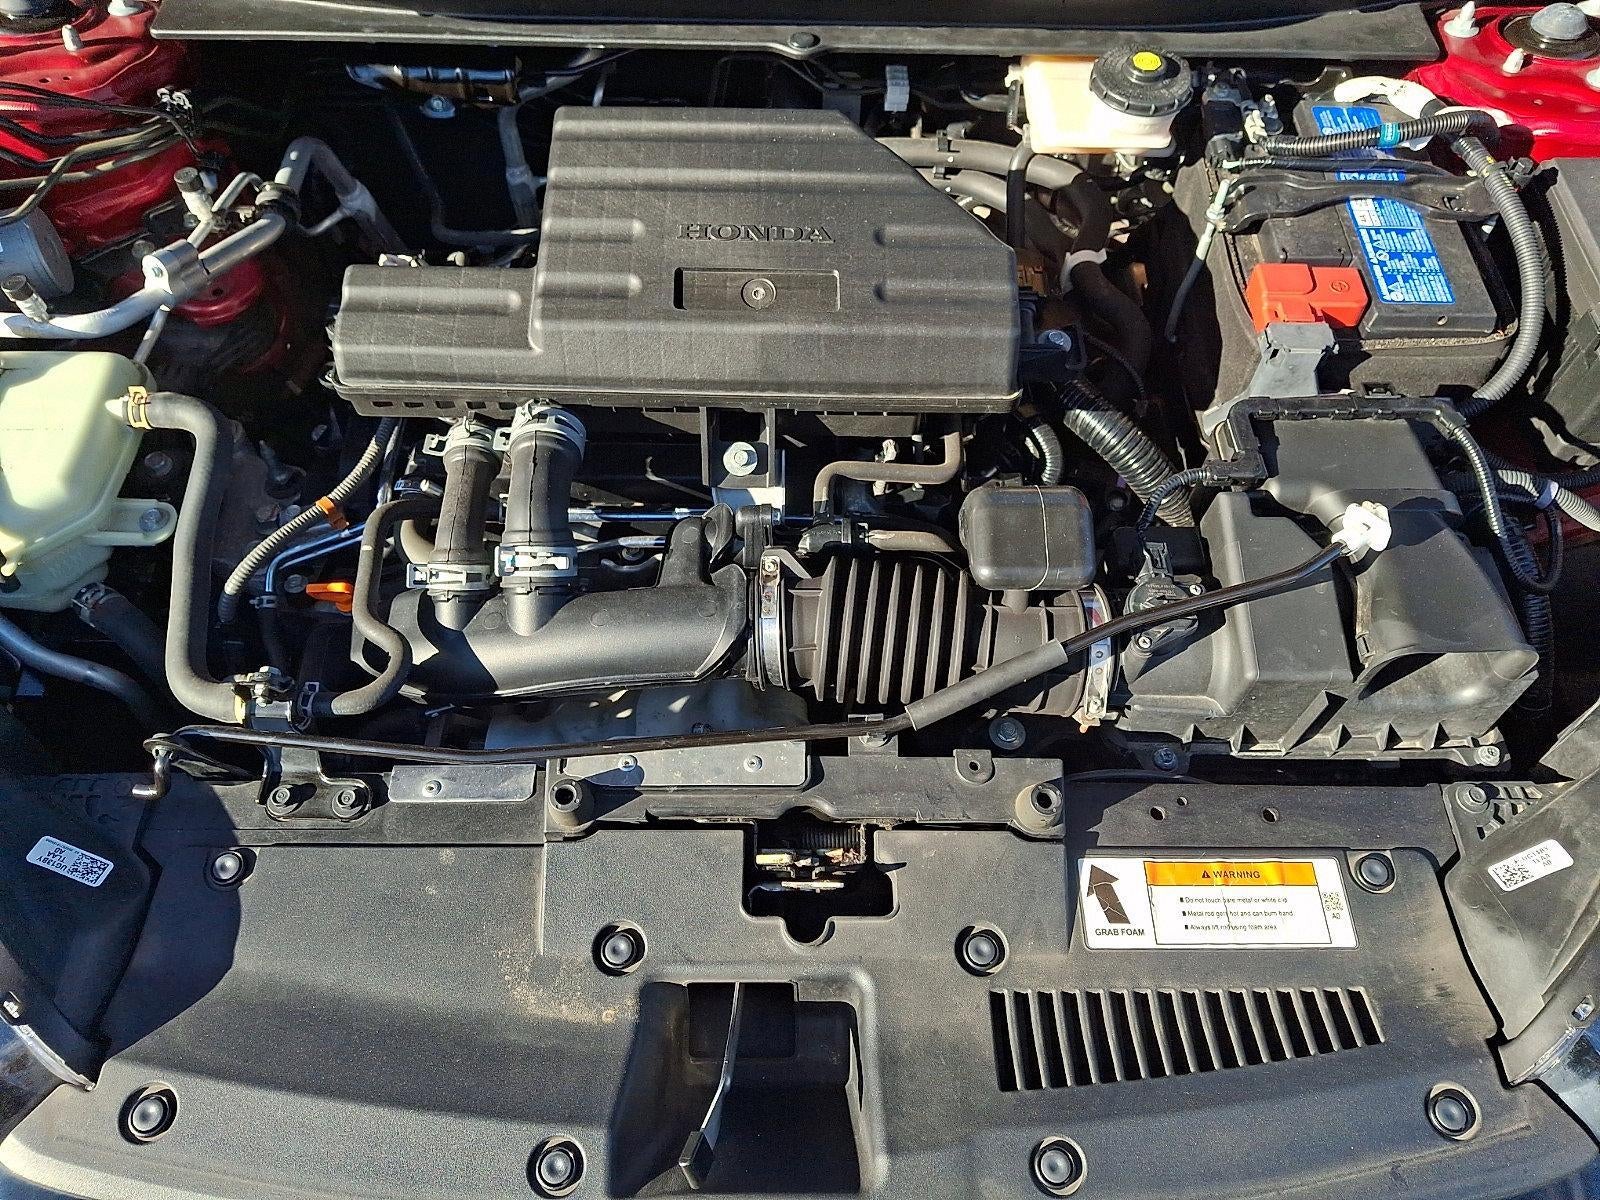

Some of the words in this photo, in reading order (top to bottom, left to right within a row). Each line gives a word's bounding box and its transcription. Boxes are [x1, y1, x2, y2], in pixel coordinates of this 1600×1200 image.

[676, 223, 836, 243] HONDA
[1212, 870, 1261, 879] WARNING
[1184, 896, 1193, 904] Do
[1094, 928, 1120, 937] GRAB
[1120, 928, 1145, 937] FOAM
